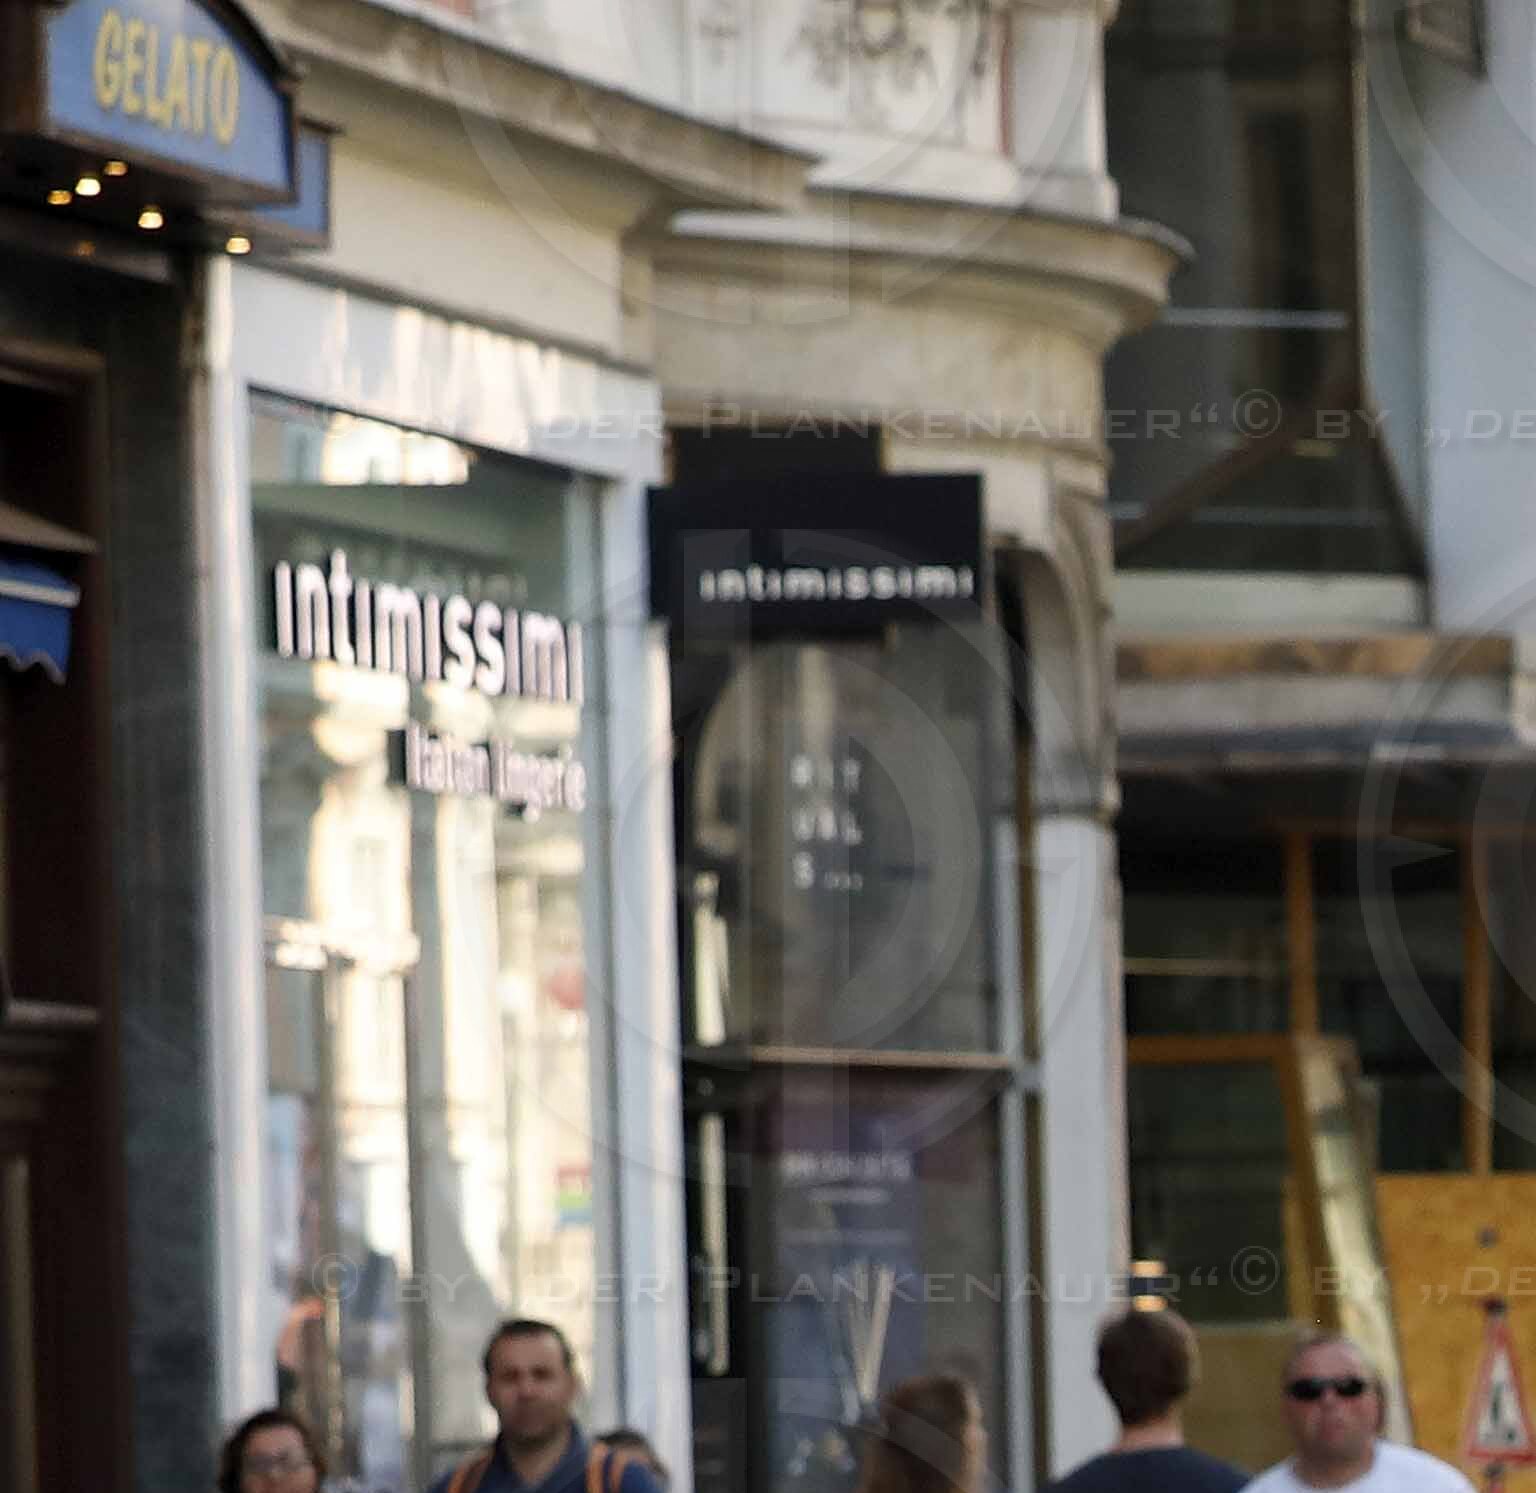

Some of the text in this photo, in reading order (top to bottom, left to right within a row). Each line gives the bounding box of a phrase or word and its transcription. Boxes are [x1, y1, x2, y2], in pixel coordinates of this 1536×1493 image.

[93, 8, 240, 146] GELATO
[274, 548, 583, 705] intimissimi
[698, 562, 975, 602] intimissimi
